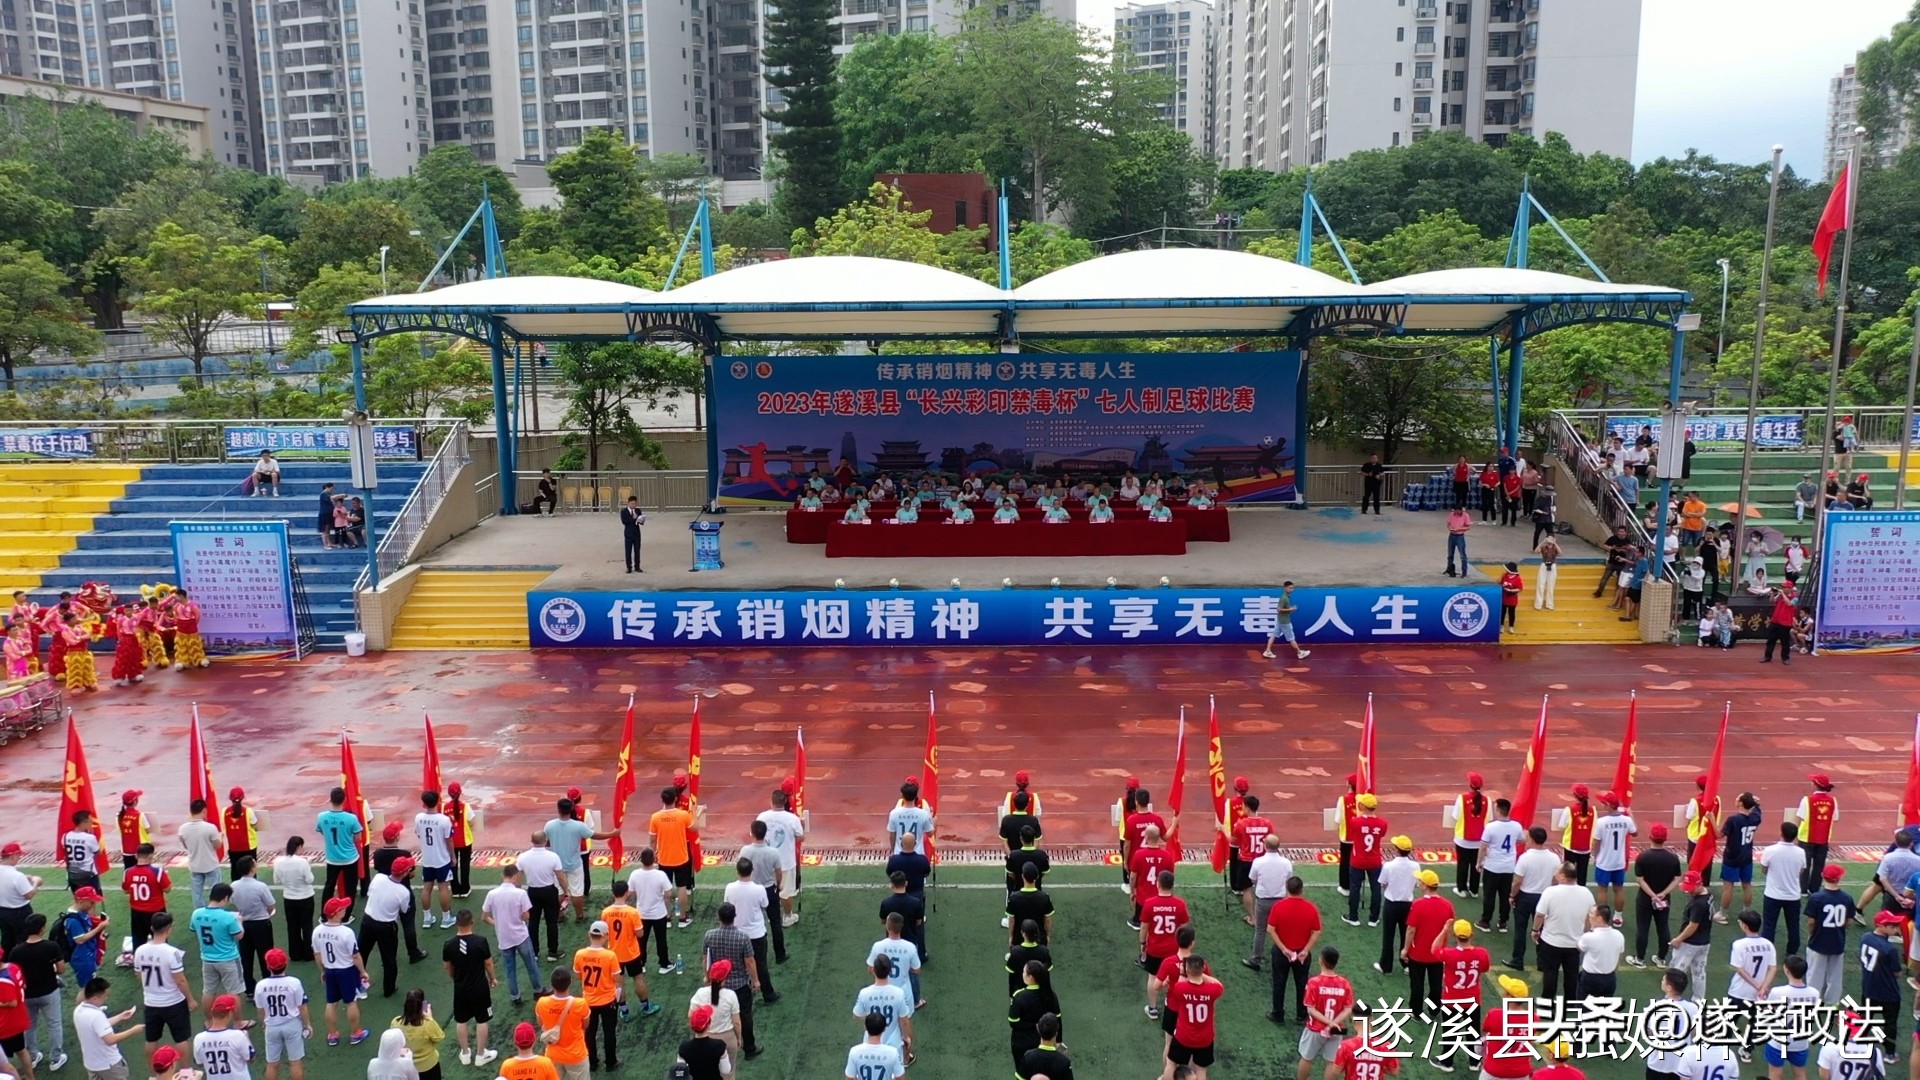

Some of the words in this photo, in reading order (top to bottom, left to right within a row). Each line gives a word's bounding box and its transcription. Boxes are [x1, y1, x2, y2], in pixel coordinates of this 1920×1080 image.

[877, 362, 992, 381] 传承销烟精神
[1020, 361, 1137, 380] 共享无毒人生
[3, 435, 88, 452] 禁毒在于行动
[607, 597, 980, 641] 传承销烟精神
[1043, 595, 1420, 639] 共享无毒人生
[330, 827, 338, 845] 1
[425, 827, 434, 846] 6
[1250, 835, 1264, 854] 15
[1364, 834, 1375, 852] 9
[1501, 834, 1511, 853] 4
[1613, 831, 1619, 850] 1
[1741, 826, 1757, 845] 15
[65, 844, 86, 862] 26
[1147, 866, 1156, 885] 4
[130, 883, 151, 901] 10
[1153, 915, 1177, 935] 25
[1822, 904, 1846, 928] 20
[202, 926, 214, 946] 5
[613, 919, 622, 941] 9
[325, 941, 335, 964] 8
[142, 965, 164, 987] 71
[1752, 955, 1763, 979] 7
[584, 966, 602, 989] 27
[1453, 970, 1480, 990] 22
[267, 994, 287, 1017] 86
[1186, 1003, 1208, 1024] 10
[1324, 998, 1336, 1020] 6
[205, 1051, 232, 1076] 33
